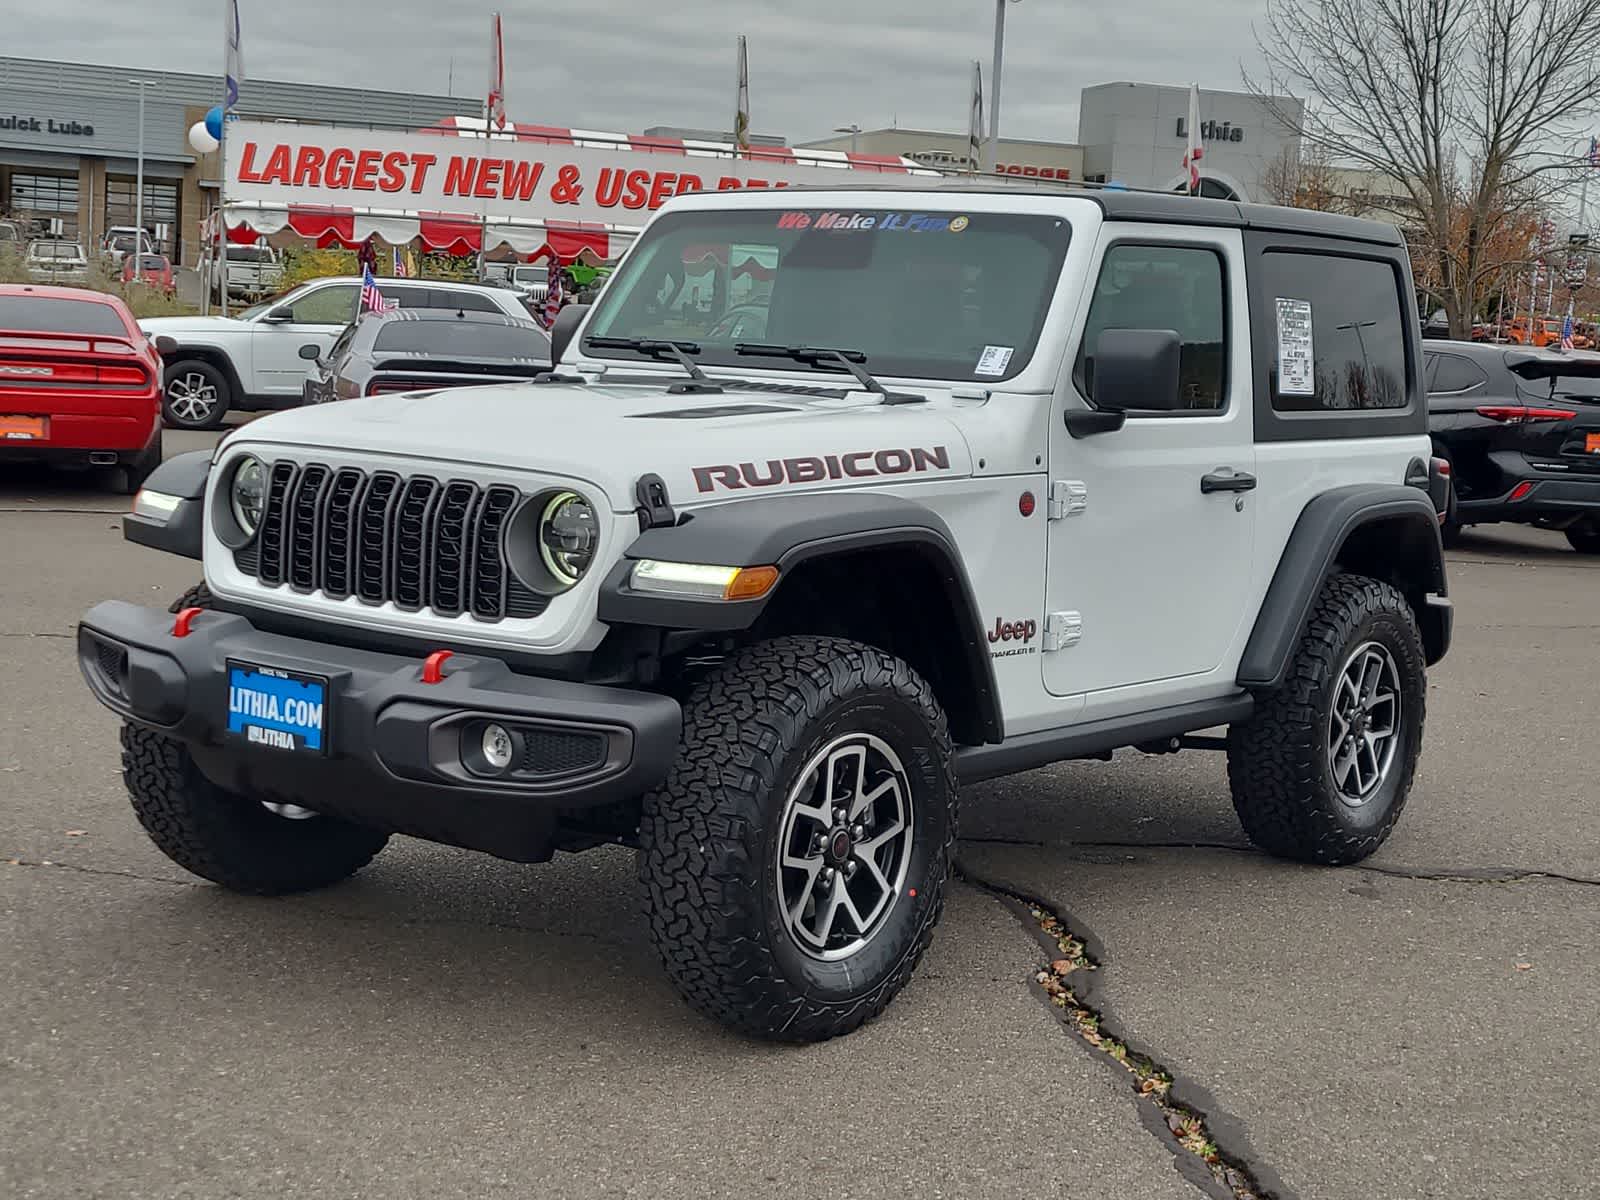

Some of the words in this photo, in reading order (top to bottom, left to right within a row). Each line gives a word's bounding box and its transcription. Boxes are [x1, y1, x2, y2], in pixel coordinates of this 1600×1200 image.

[0, 115, 41, 132] uick
[47, 118, 94, 136] Lube
[1176, 117, 1243, 142] Lthia
[238, 142, 437, 194] LARGEST
[443, 155, 545, 201] NEW
[550, 164, 584, 206] &
[777, 211, 811, 229] We
[814, 212, 876, 230] Make
[902, 214, 949, 231] Fun
[692, 446, 951, 493] RUBICON
[987, 616, 1036, 644] Jeep
[229, 686, 323, 730] LITHIA.COM
